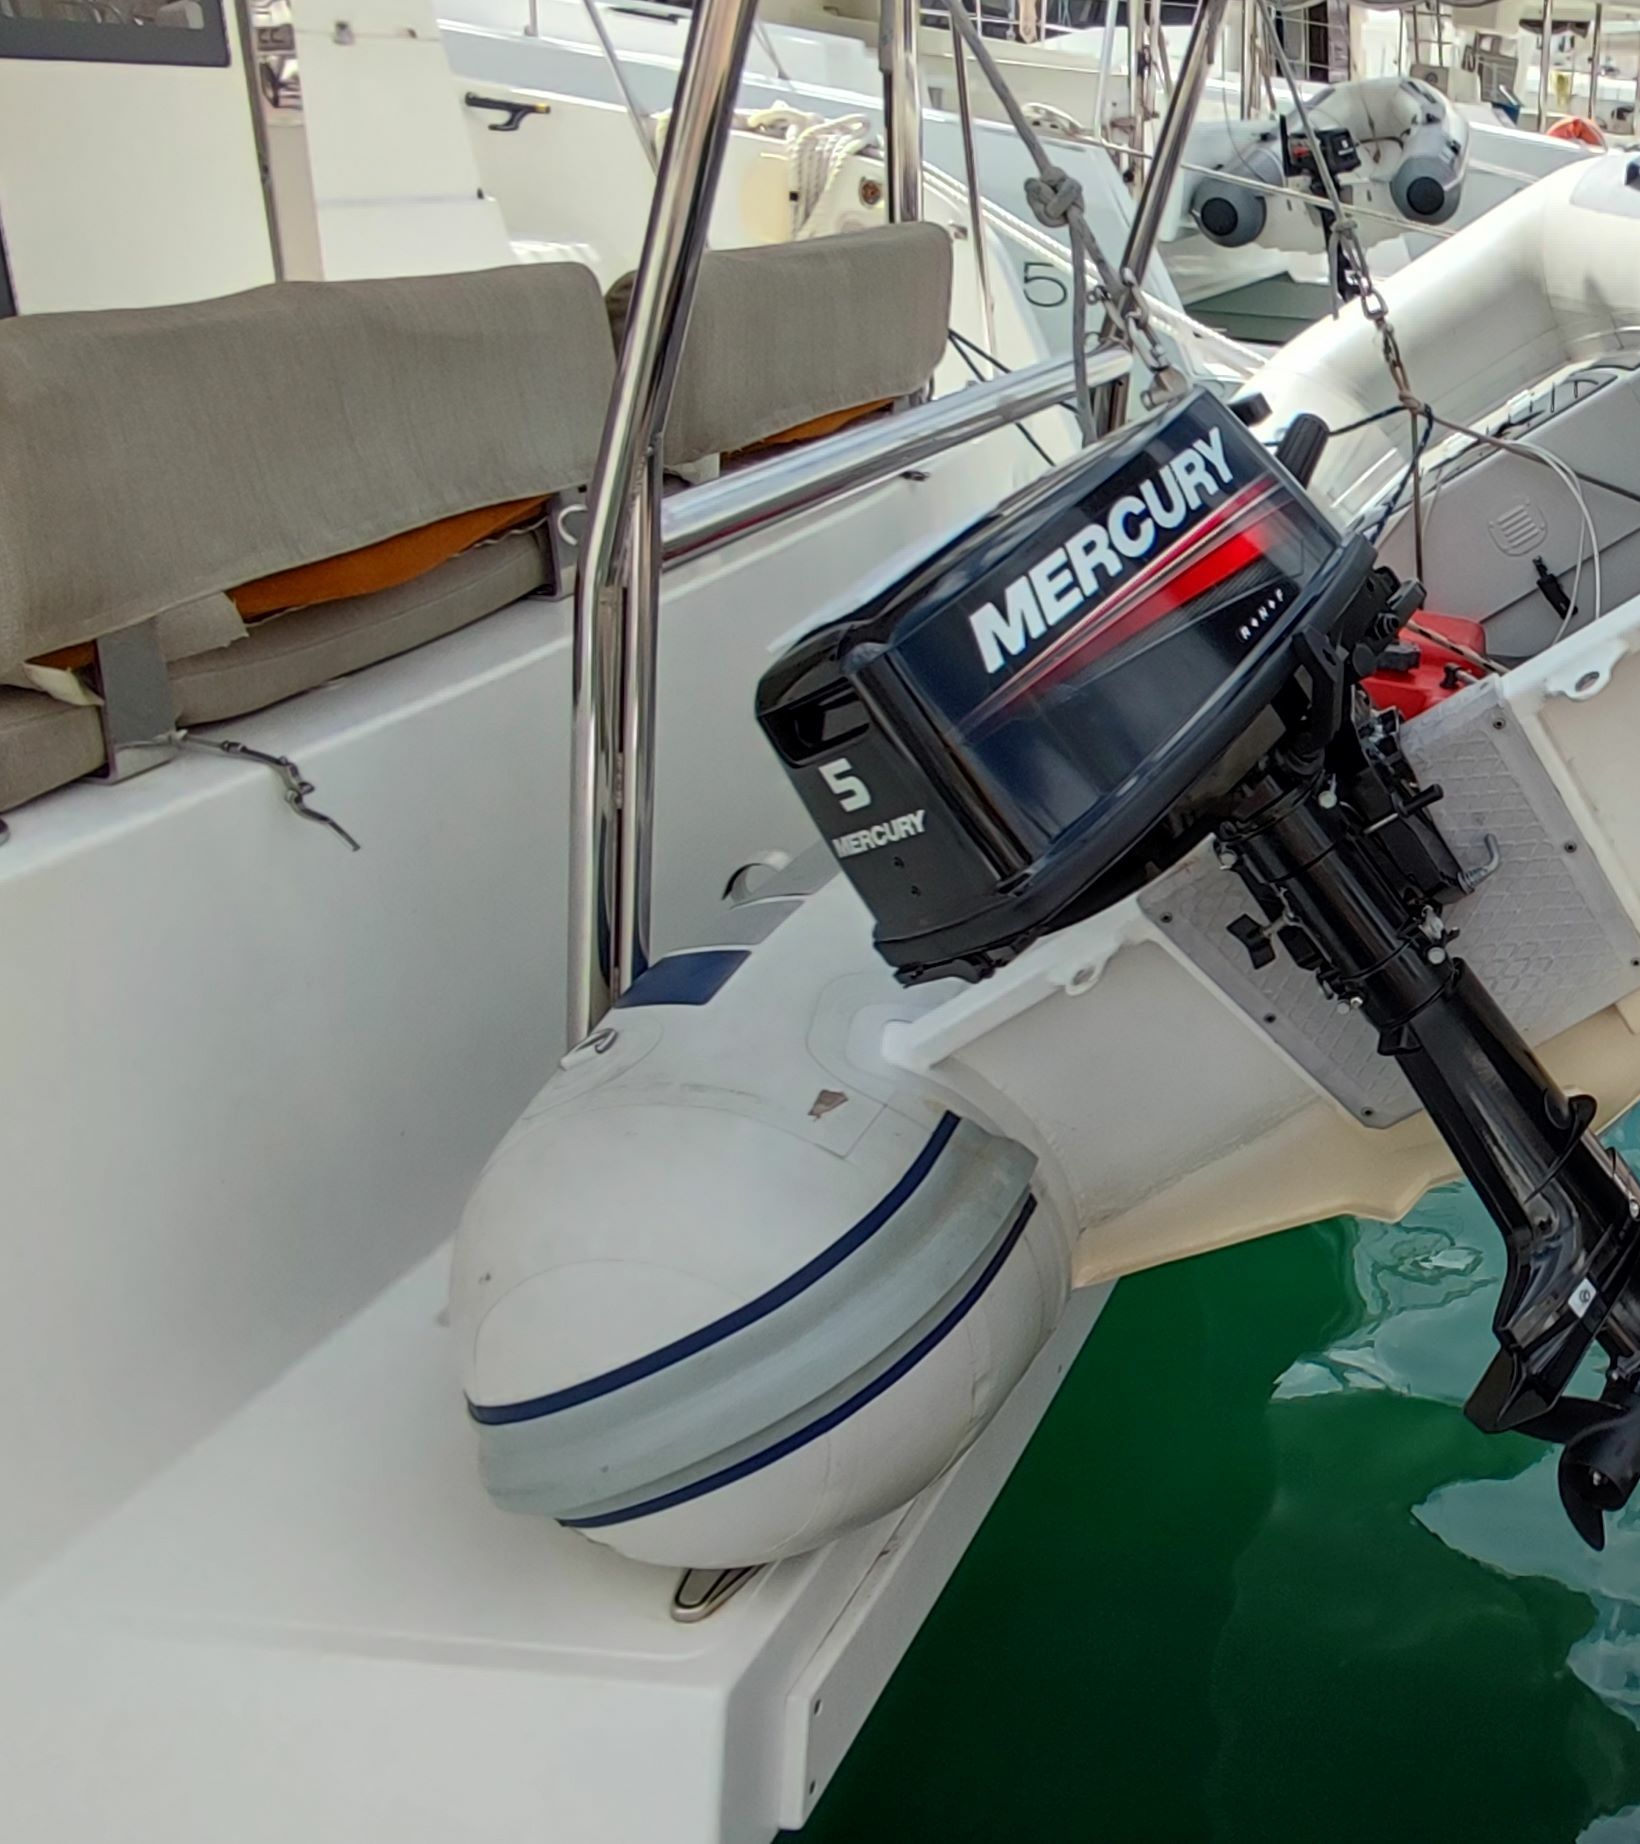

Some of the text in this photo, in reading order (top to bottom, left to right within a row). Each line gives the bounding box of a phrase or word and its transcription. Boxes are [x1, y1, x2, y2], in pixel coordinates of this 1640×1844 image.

[1023, 261, 1068, 308] 5
[969, 427, 1233, 674] MERCURY
[818, 757, 872, 812] 5
[832, 809, 926, 858] MERCURY
